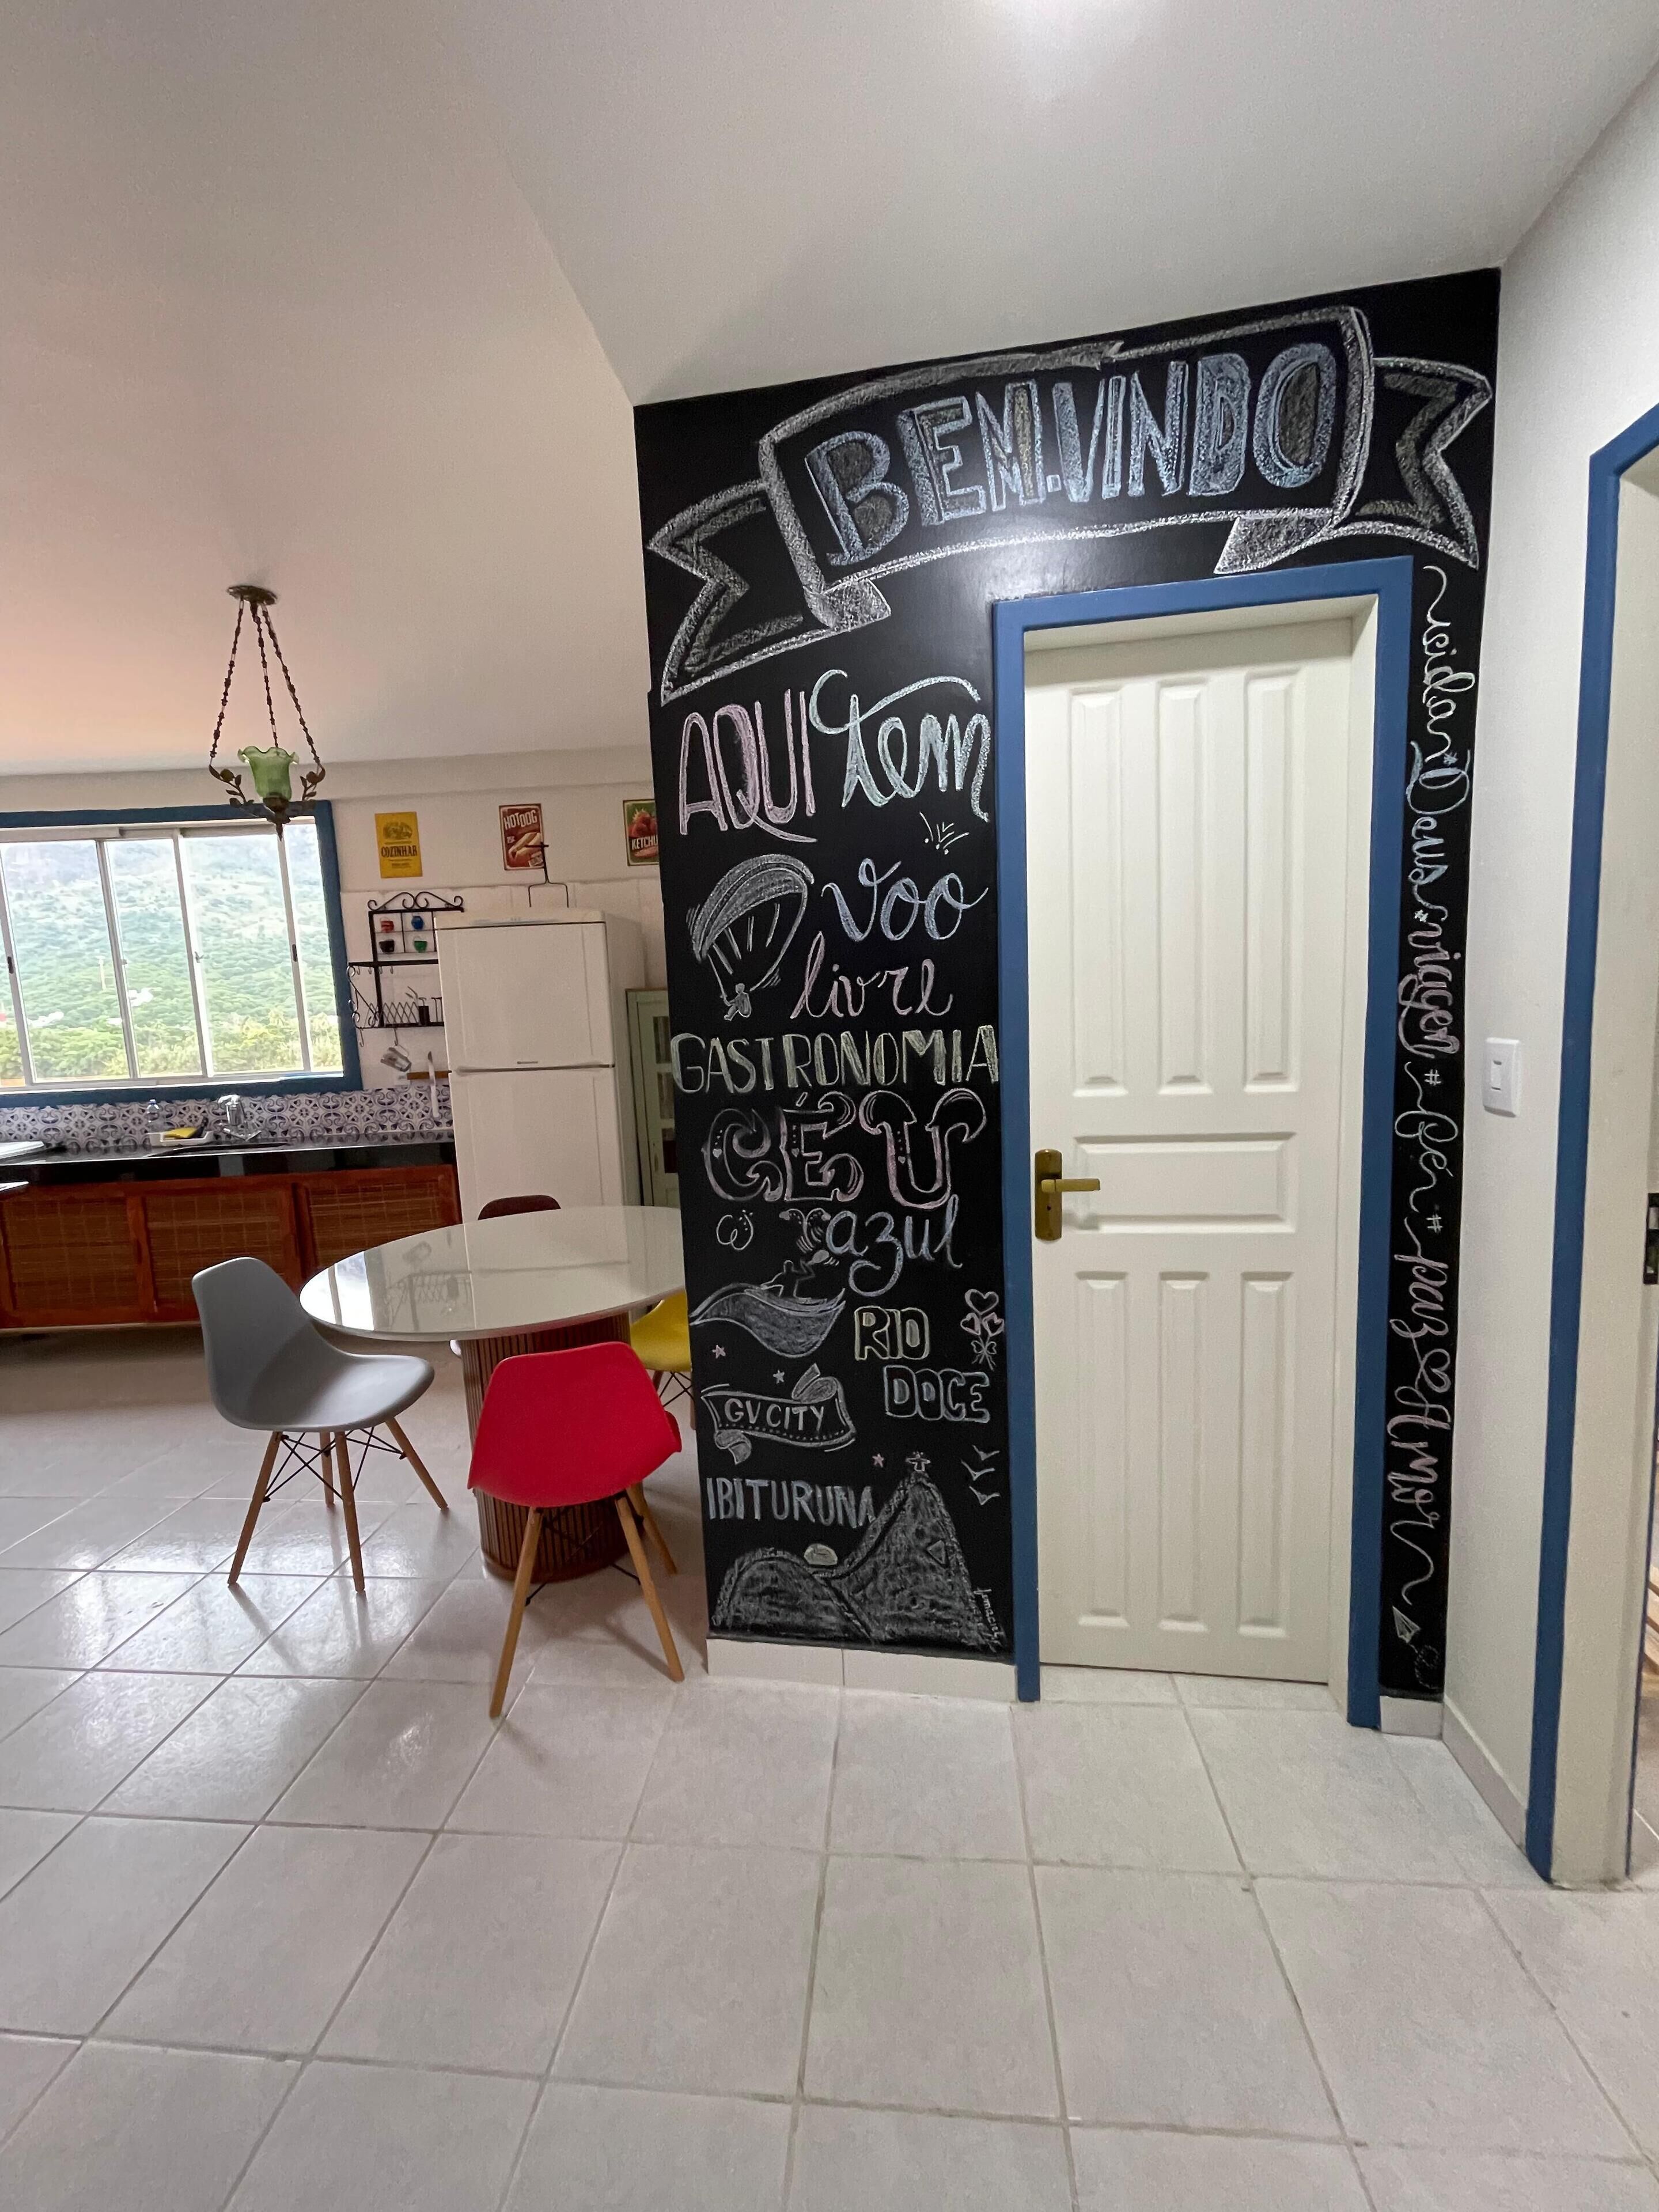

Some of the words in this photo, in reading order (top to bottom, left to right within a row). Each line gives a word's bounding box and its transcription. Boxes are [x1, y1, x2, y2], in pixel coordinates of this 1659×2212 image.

[679, 688, 817, 843] AQUI
[632, 835, 658, 850] KETCHU
[1406, 741, 1469, 922] Deus
[790, 931, 954, 1020] livre
[671, 1025, 999, 1093] GASTRONOMIA
[702, 1087, 987, 1210] CÉU
[825, 1194, 963, 1297] azul
[1388, 1221, 1450, 1338] paz
[854, 1305, 930, 1361] RIO
[765, 1405, 825, 1431] CITY
[883, 1364, 990, 1423] DOCE
[706, 1477, 878, 1529] IBITURUNA
[1385, 1387, 1452, 1581] Amor
